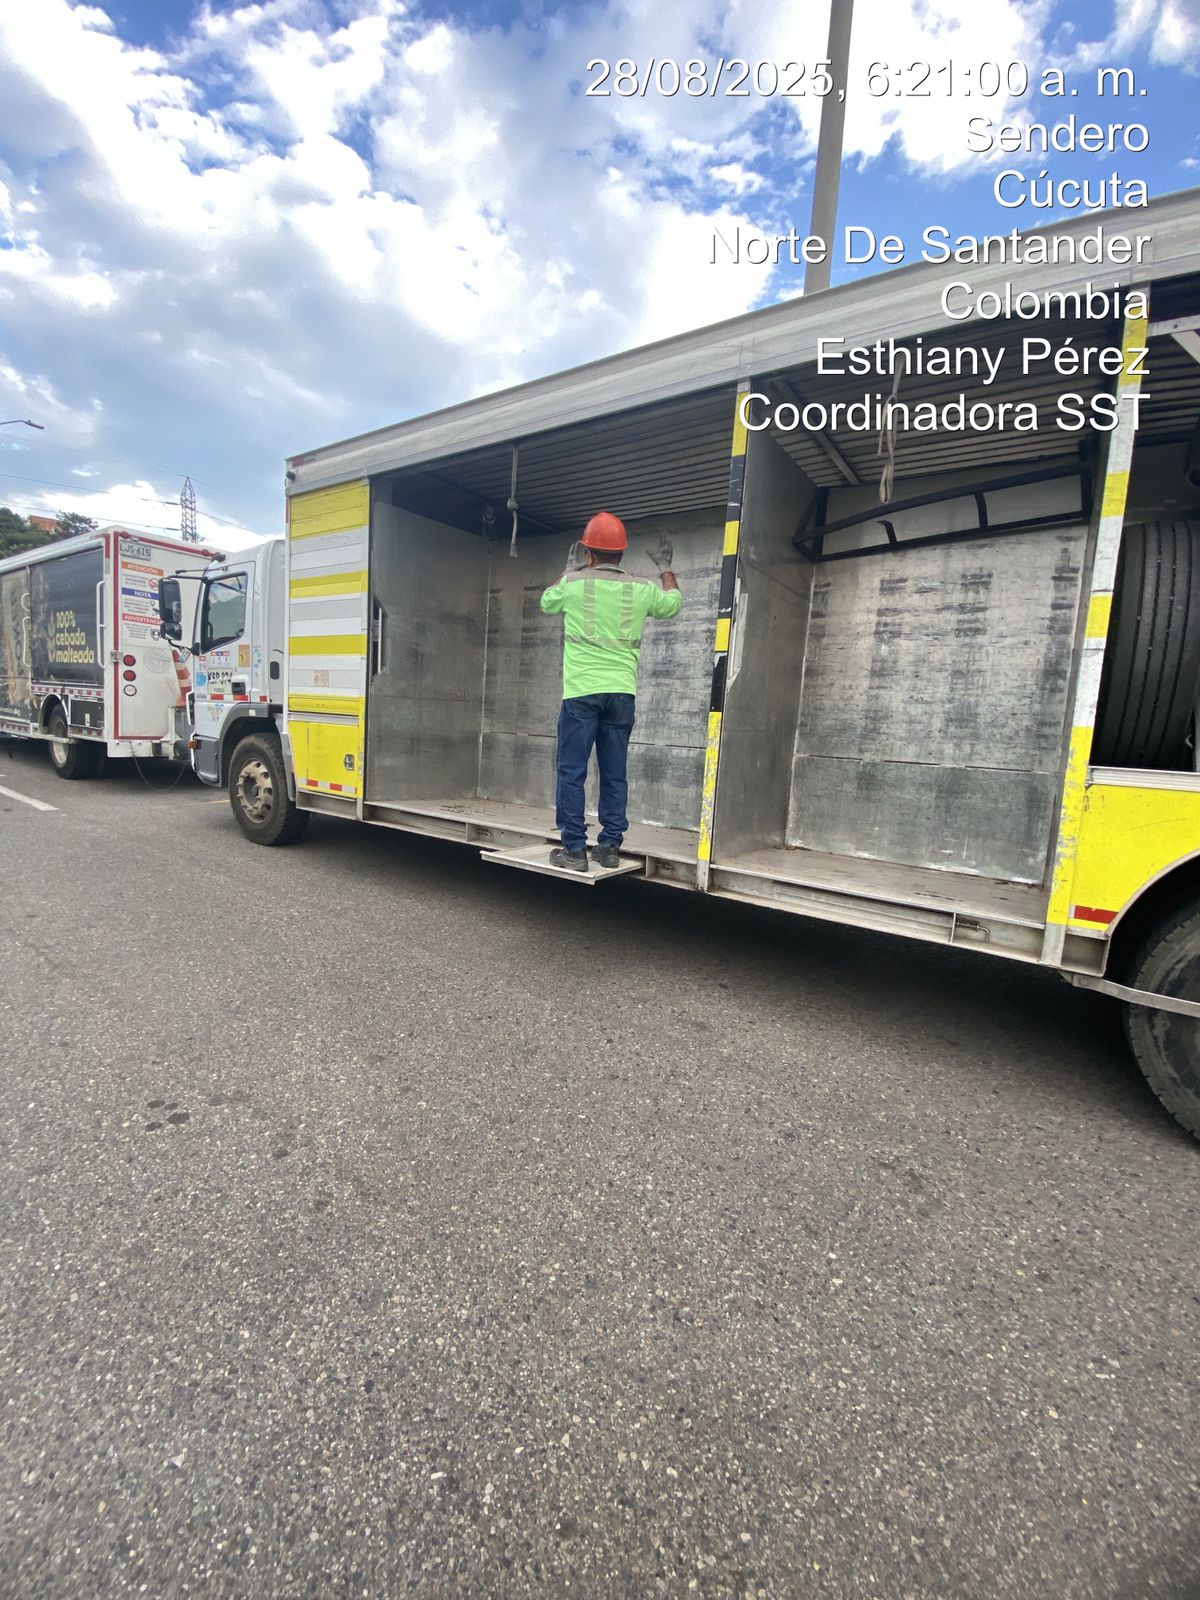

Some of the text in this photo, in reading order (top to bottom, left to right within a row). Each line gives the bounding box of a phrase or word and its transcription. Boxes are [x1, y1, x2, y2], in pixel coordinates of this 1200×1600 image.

[136, 547, 151, 557] 615
[56, 610, 76, 629] 100%
[123, 614, 163, 625] ADVERTENCI
[55, 627, 86, 646] cebada
[55, 645, 95, 664] malteada
